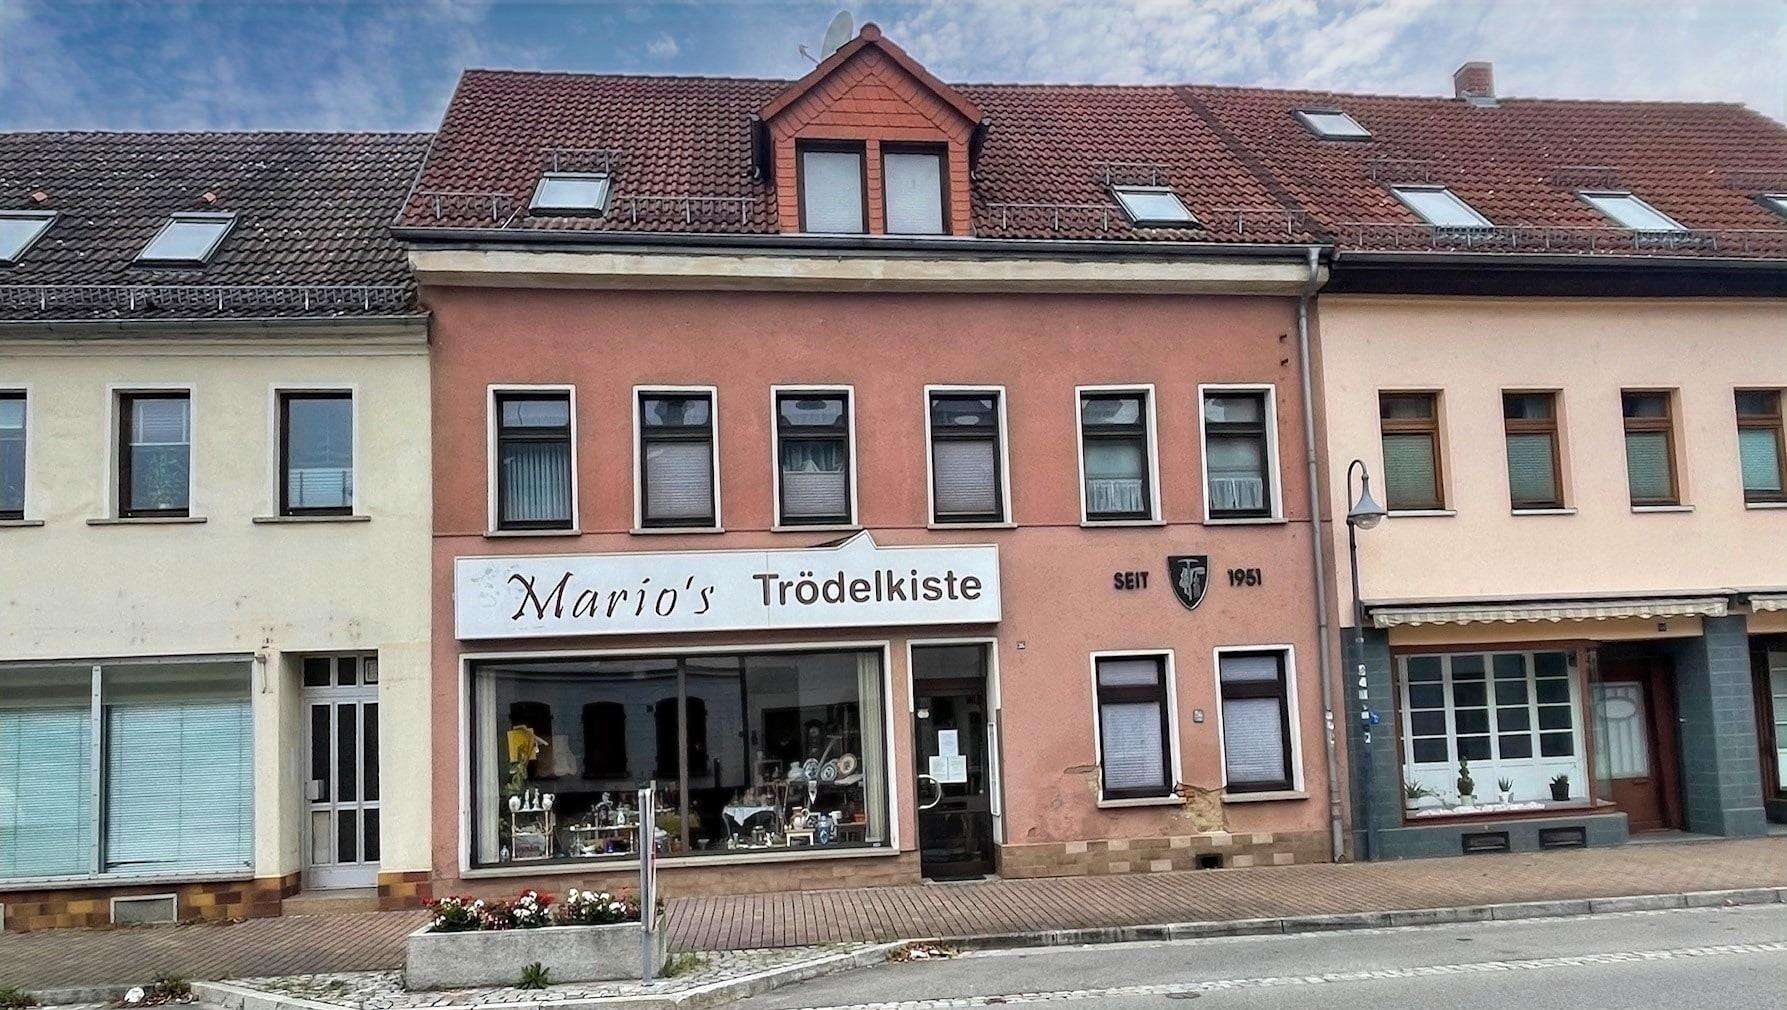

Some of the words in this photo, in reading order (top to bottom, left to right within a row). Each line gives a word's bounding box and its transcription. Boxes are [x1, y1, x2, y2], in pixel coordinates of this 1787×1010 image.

[507, 571, 715, 621] Mario's
[752, 568, 983, 606] Trödelkiste
[1113, 571, 1149, 590] SEIT
[1227, 568, 1262, 587] 1951
